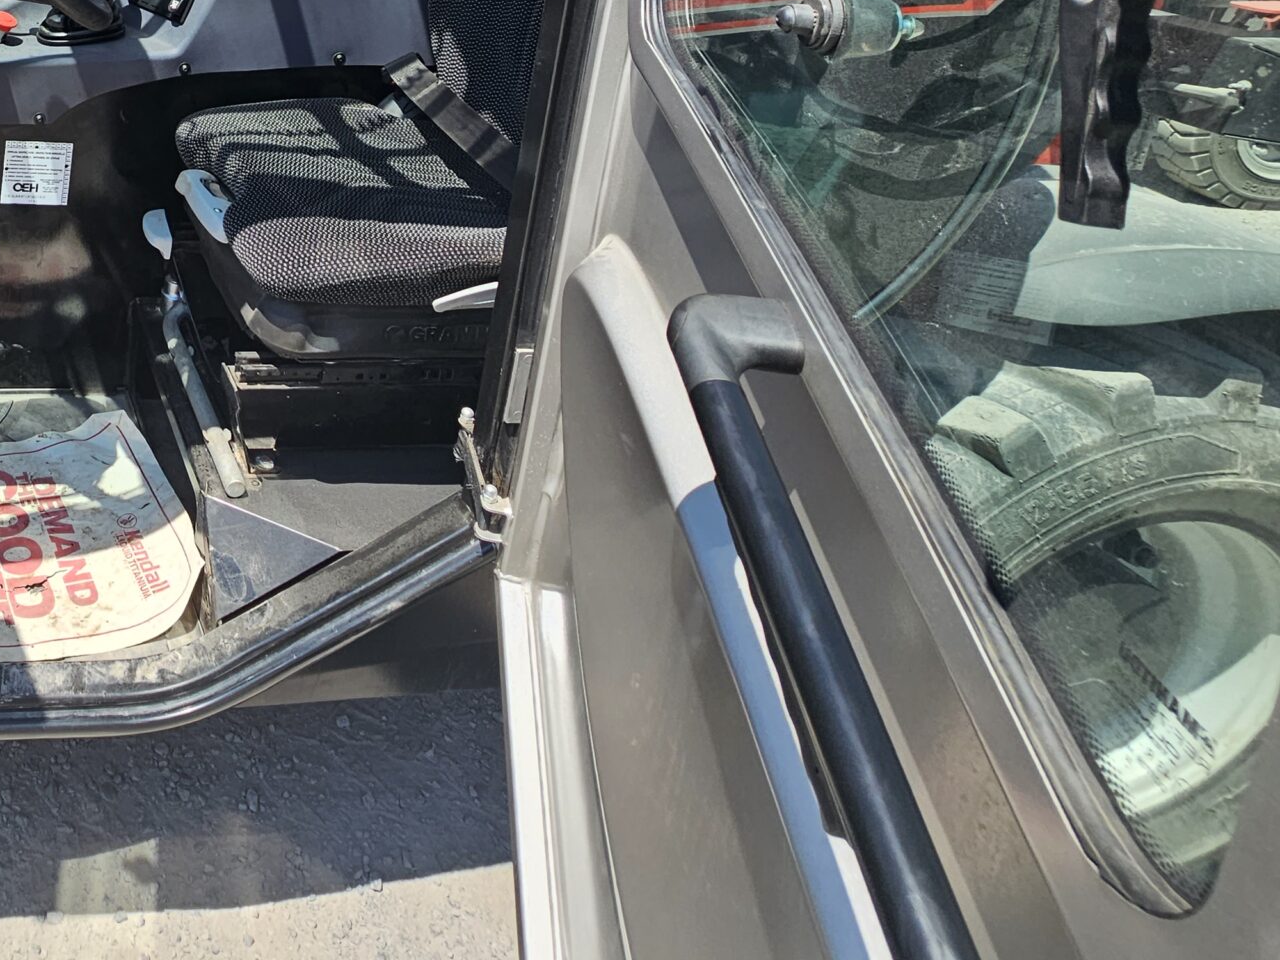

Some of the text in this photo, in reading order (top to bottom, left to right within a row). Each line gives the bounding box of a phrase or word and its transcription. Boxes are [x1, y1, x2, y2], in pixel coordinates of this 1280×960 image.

[13, 183, 39, 193] OEH
[16, 471, 37, 507] THE
[31, 475, 99, 607] DEMAND
[124, 529, 171, 595] Kendall
